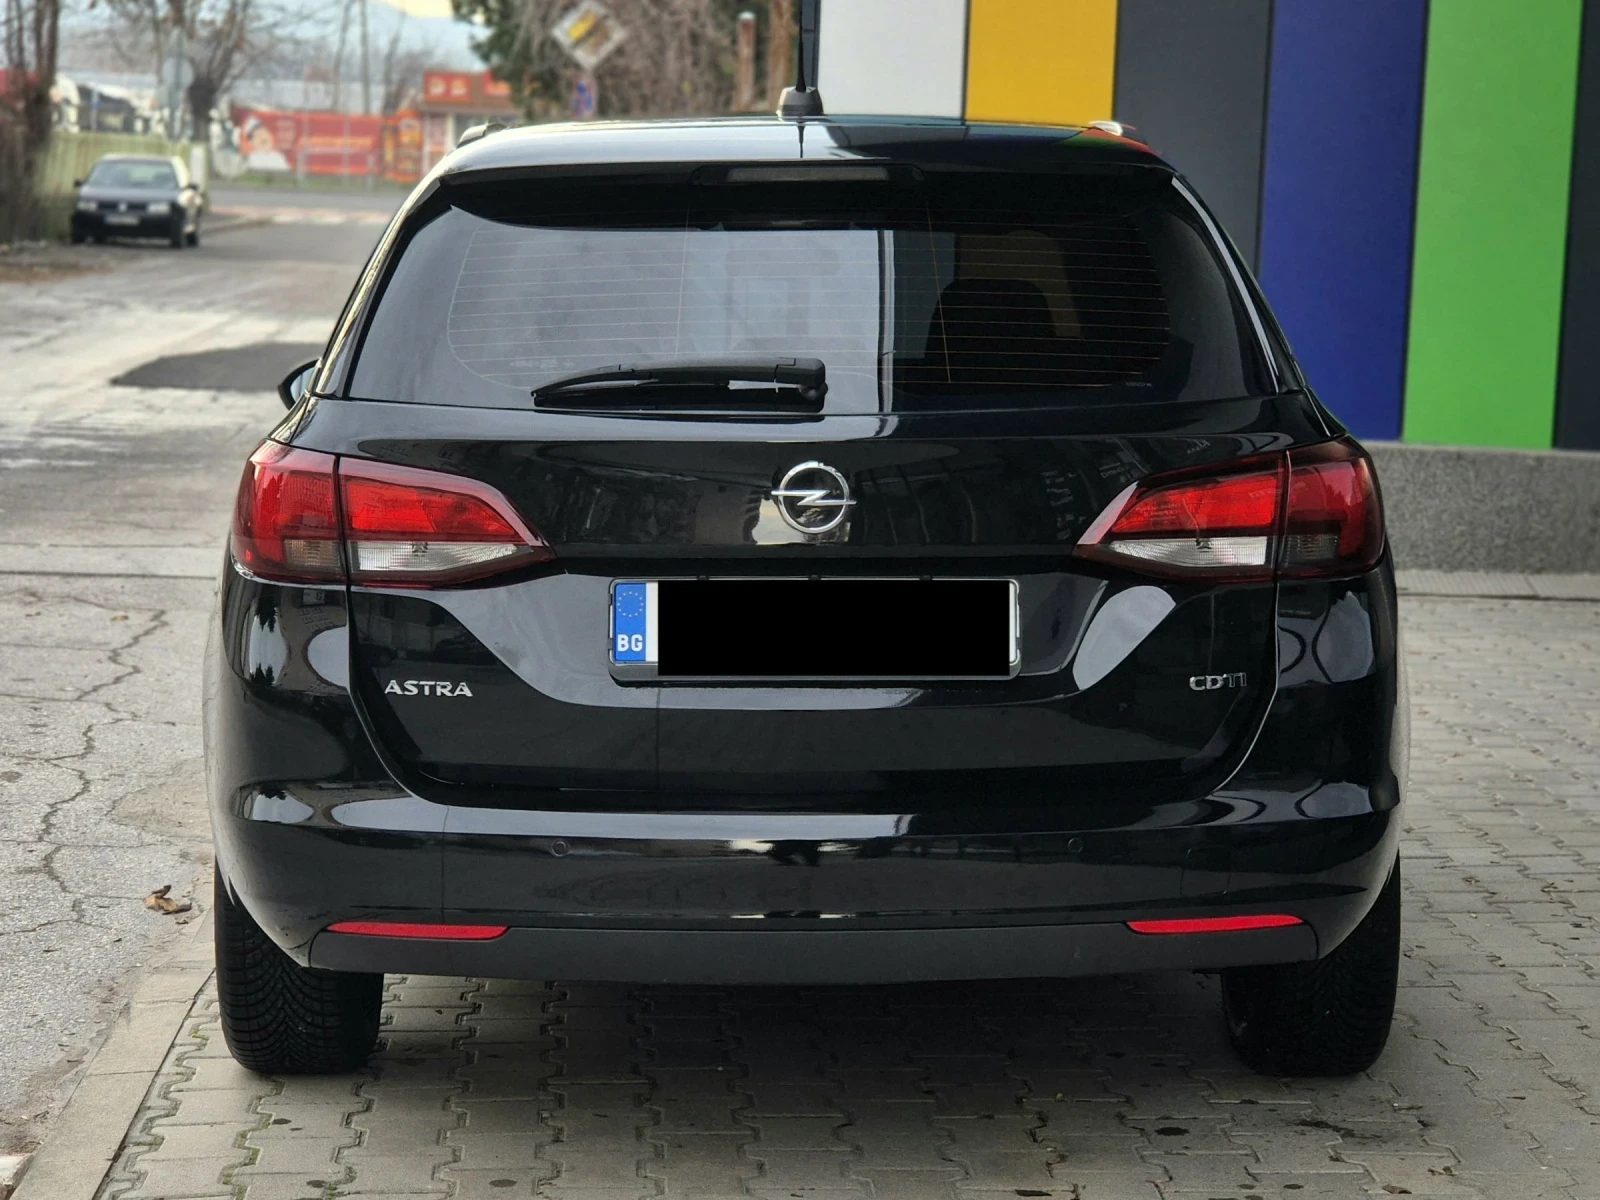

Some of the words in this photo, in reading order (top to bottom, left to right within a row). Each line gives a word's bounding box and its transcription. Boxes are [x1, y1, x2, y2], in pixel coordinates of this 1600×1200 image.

[617, 634, 643, 652] BG
[384, 680, 473, 697] ASTRA
[1189, 672, 1247, 691] CDTI
